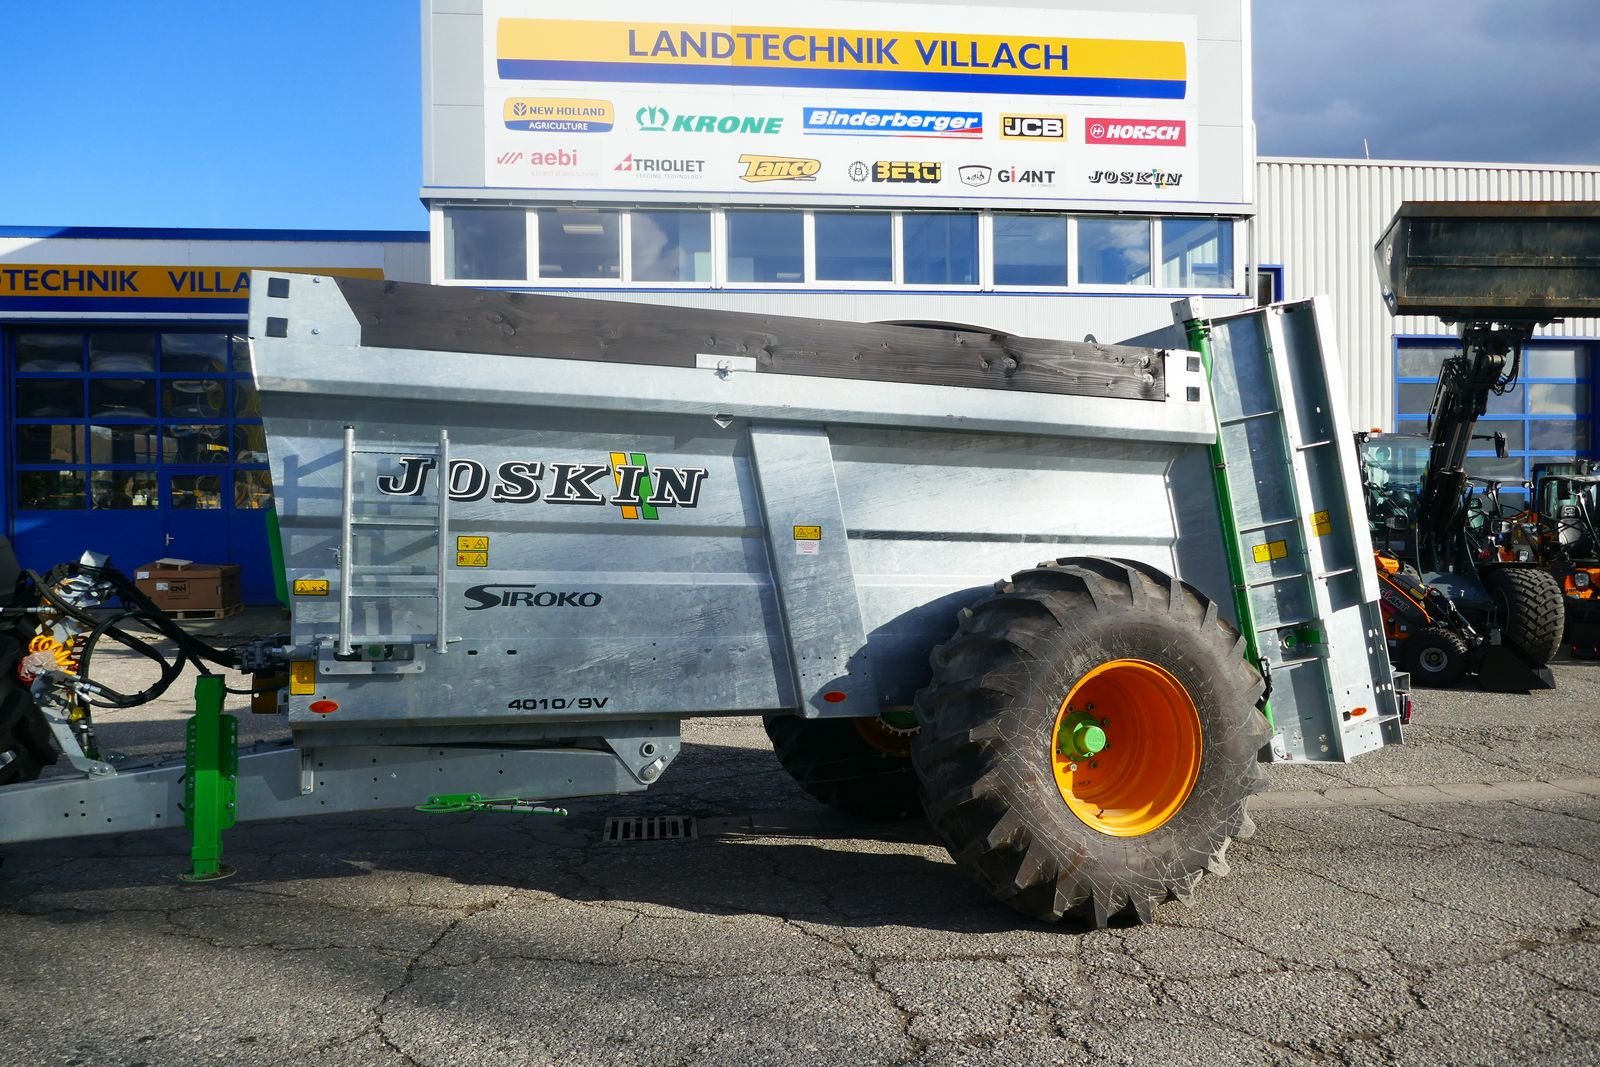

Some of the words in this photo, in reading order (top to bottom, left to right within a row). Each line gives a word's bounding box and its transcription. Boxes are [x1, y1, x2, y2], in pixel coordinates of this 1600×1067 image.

[628, 29, 899, 65] LANDTECHNIK
[914, 39, 1069, 71] VILLACH
[529, 106, 554, 115] NEW
[556, 107, 606, 116] HOLLAND
[528, 121, 589, 131] AGRICULTURE
[671, 114, 784, 135] KRONE
[808, 111, 979, 131] Binderberger
[1003, 118, 1063, 137] JCB
[1105, 124, 1181, 140] HORSCH
[530, 148, 578, 166] aebi
[633, 158, 705, 173] TRIOLIET
[738, 154, 821, 178] Tanco
[1088, 169, 1183, 187] JOSKIN
[0, 269, 139, 293] TECHNIK
[376, 456, 709, 509] JOSKIN
[507, 697, 609, 711] 4010/9V
